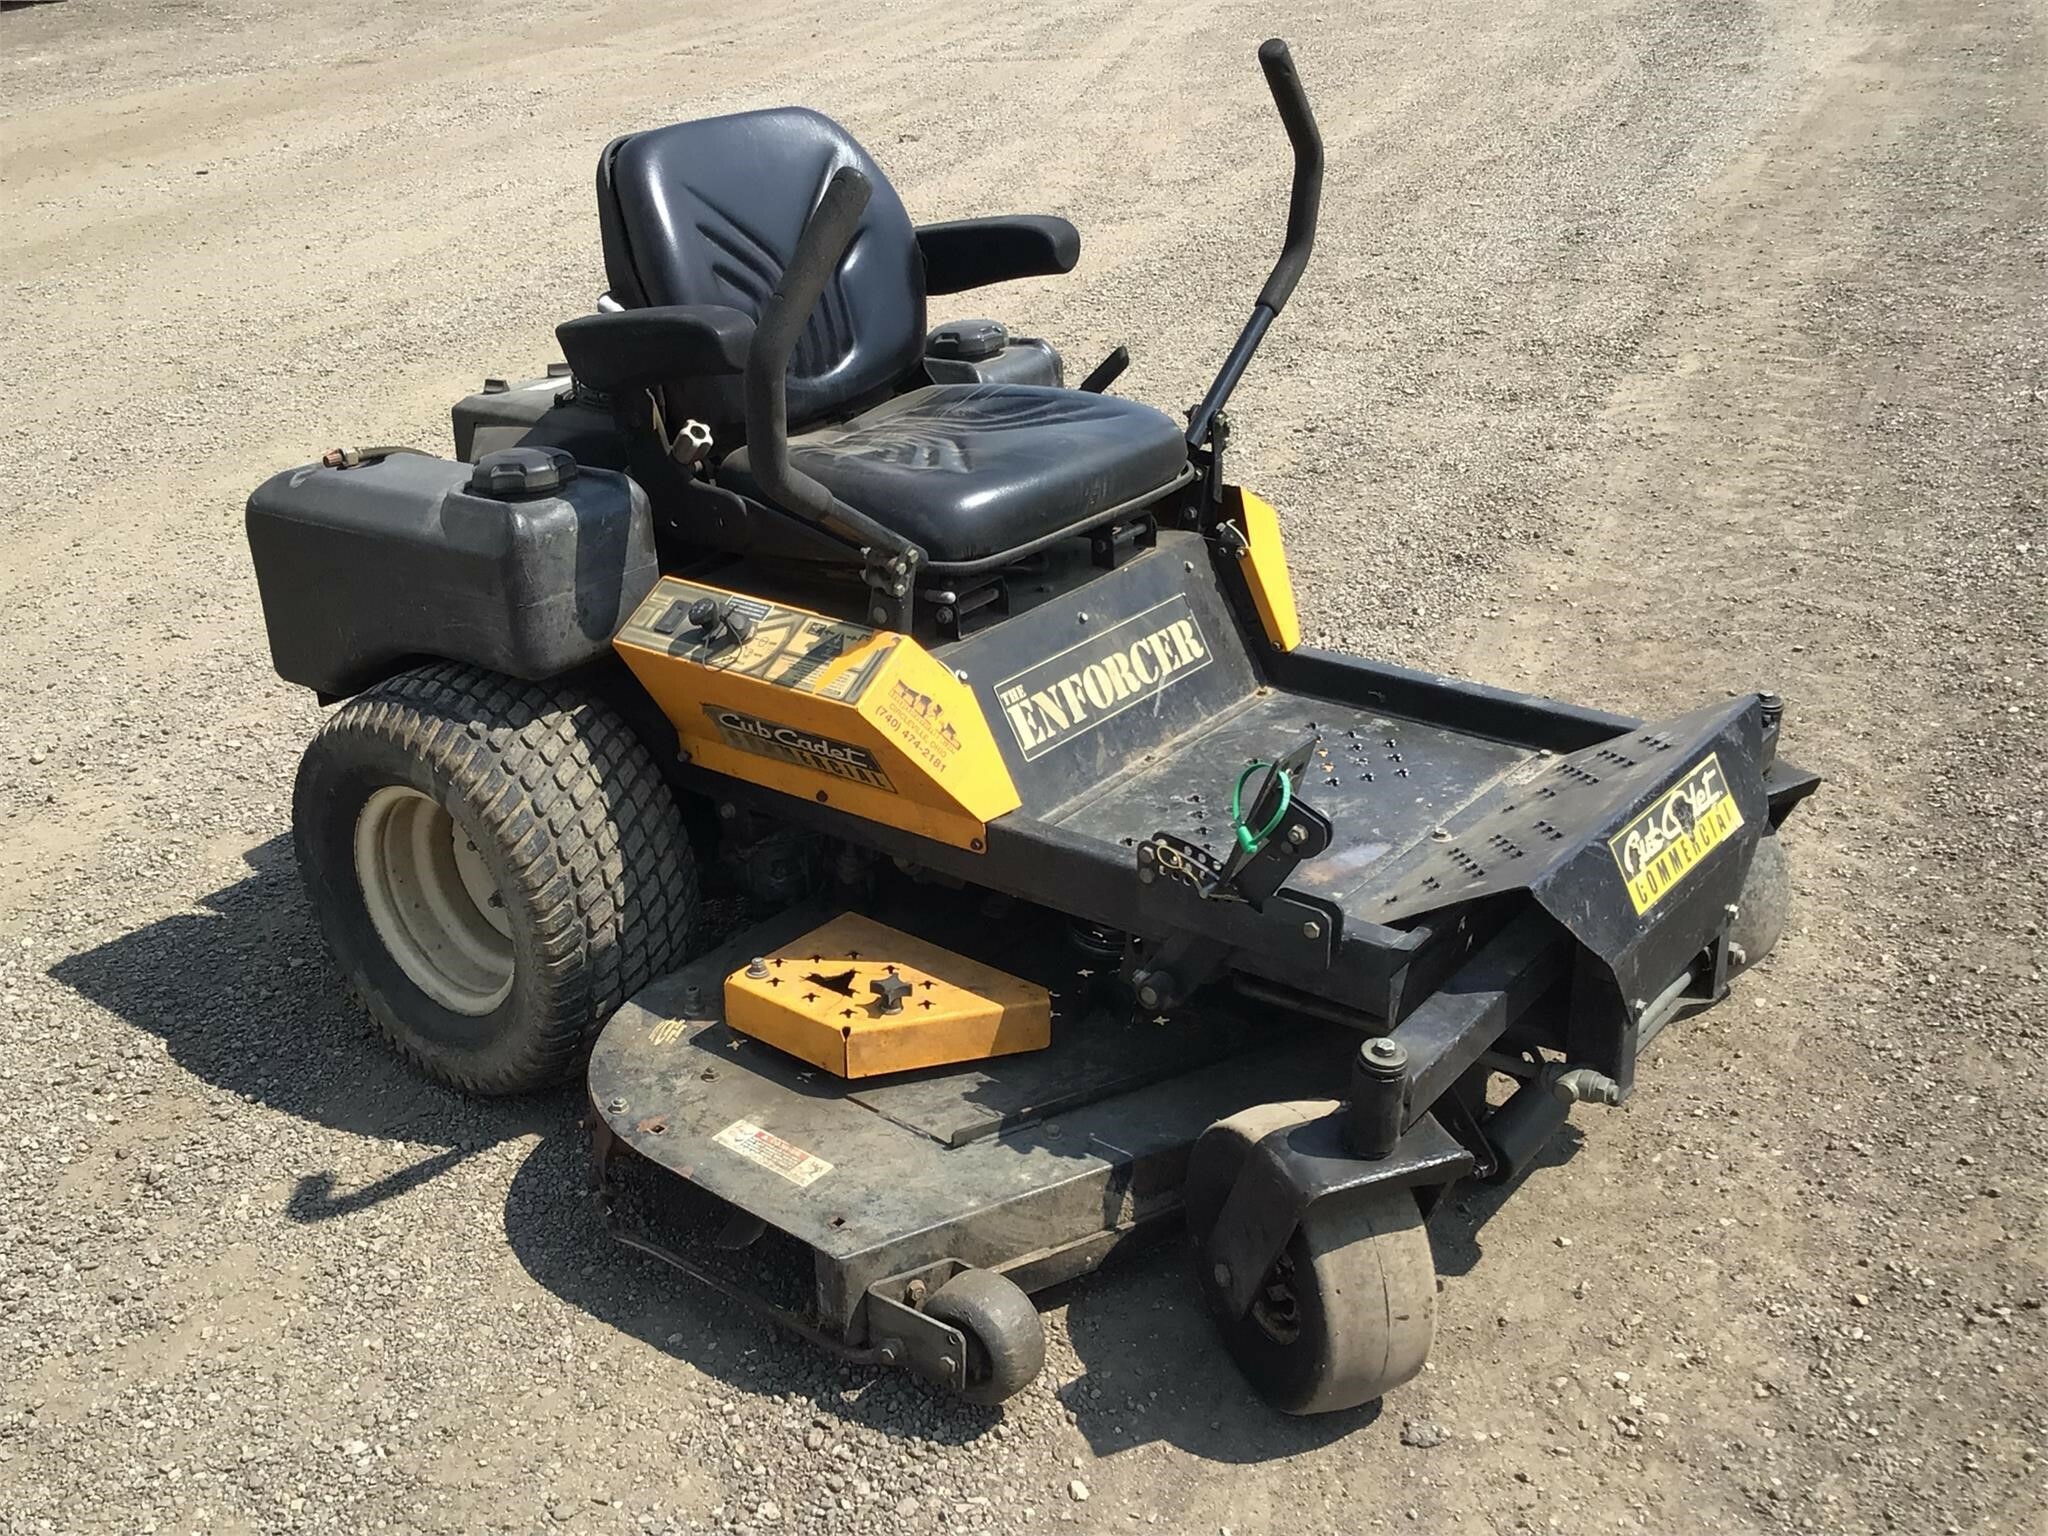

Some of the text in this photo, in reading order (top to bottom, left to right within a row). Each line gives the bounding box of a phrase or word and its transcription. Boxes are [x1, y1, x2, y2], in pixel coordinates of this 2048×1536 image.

[1000, 684, 1027, 706] THE
[1007, 619, 1204, 750] ENFORCER
[720, 713, 868, 768] Cub Cadet
[875, 705, 902, 732] (740)
[902, 731, 946, 773] 474-2181
[1662, 769, 1720, 840] Cdet
[1634, 802, 1731, 904] COMMERCIAL
